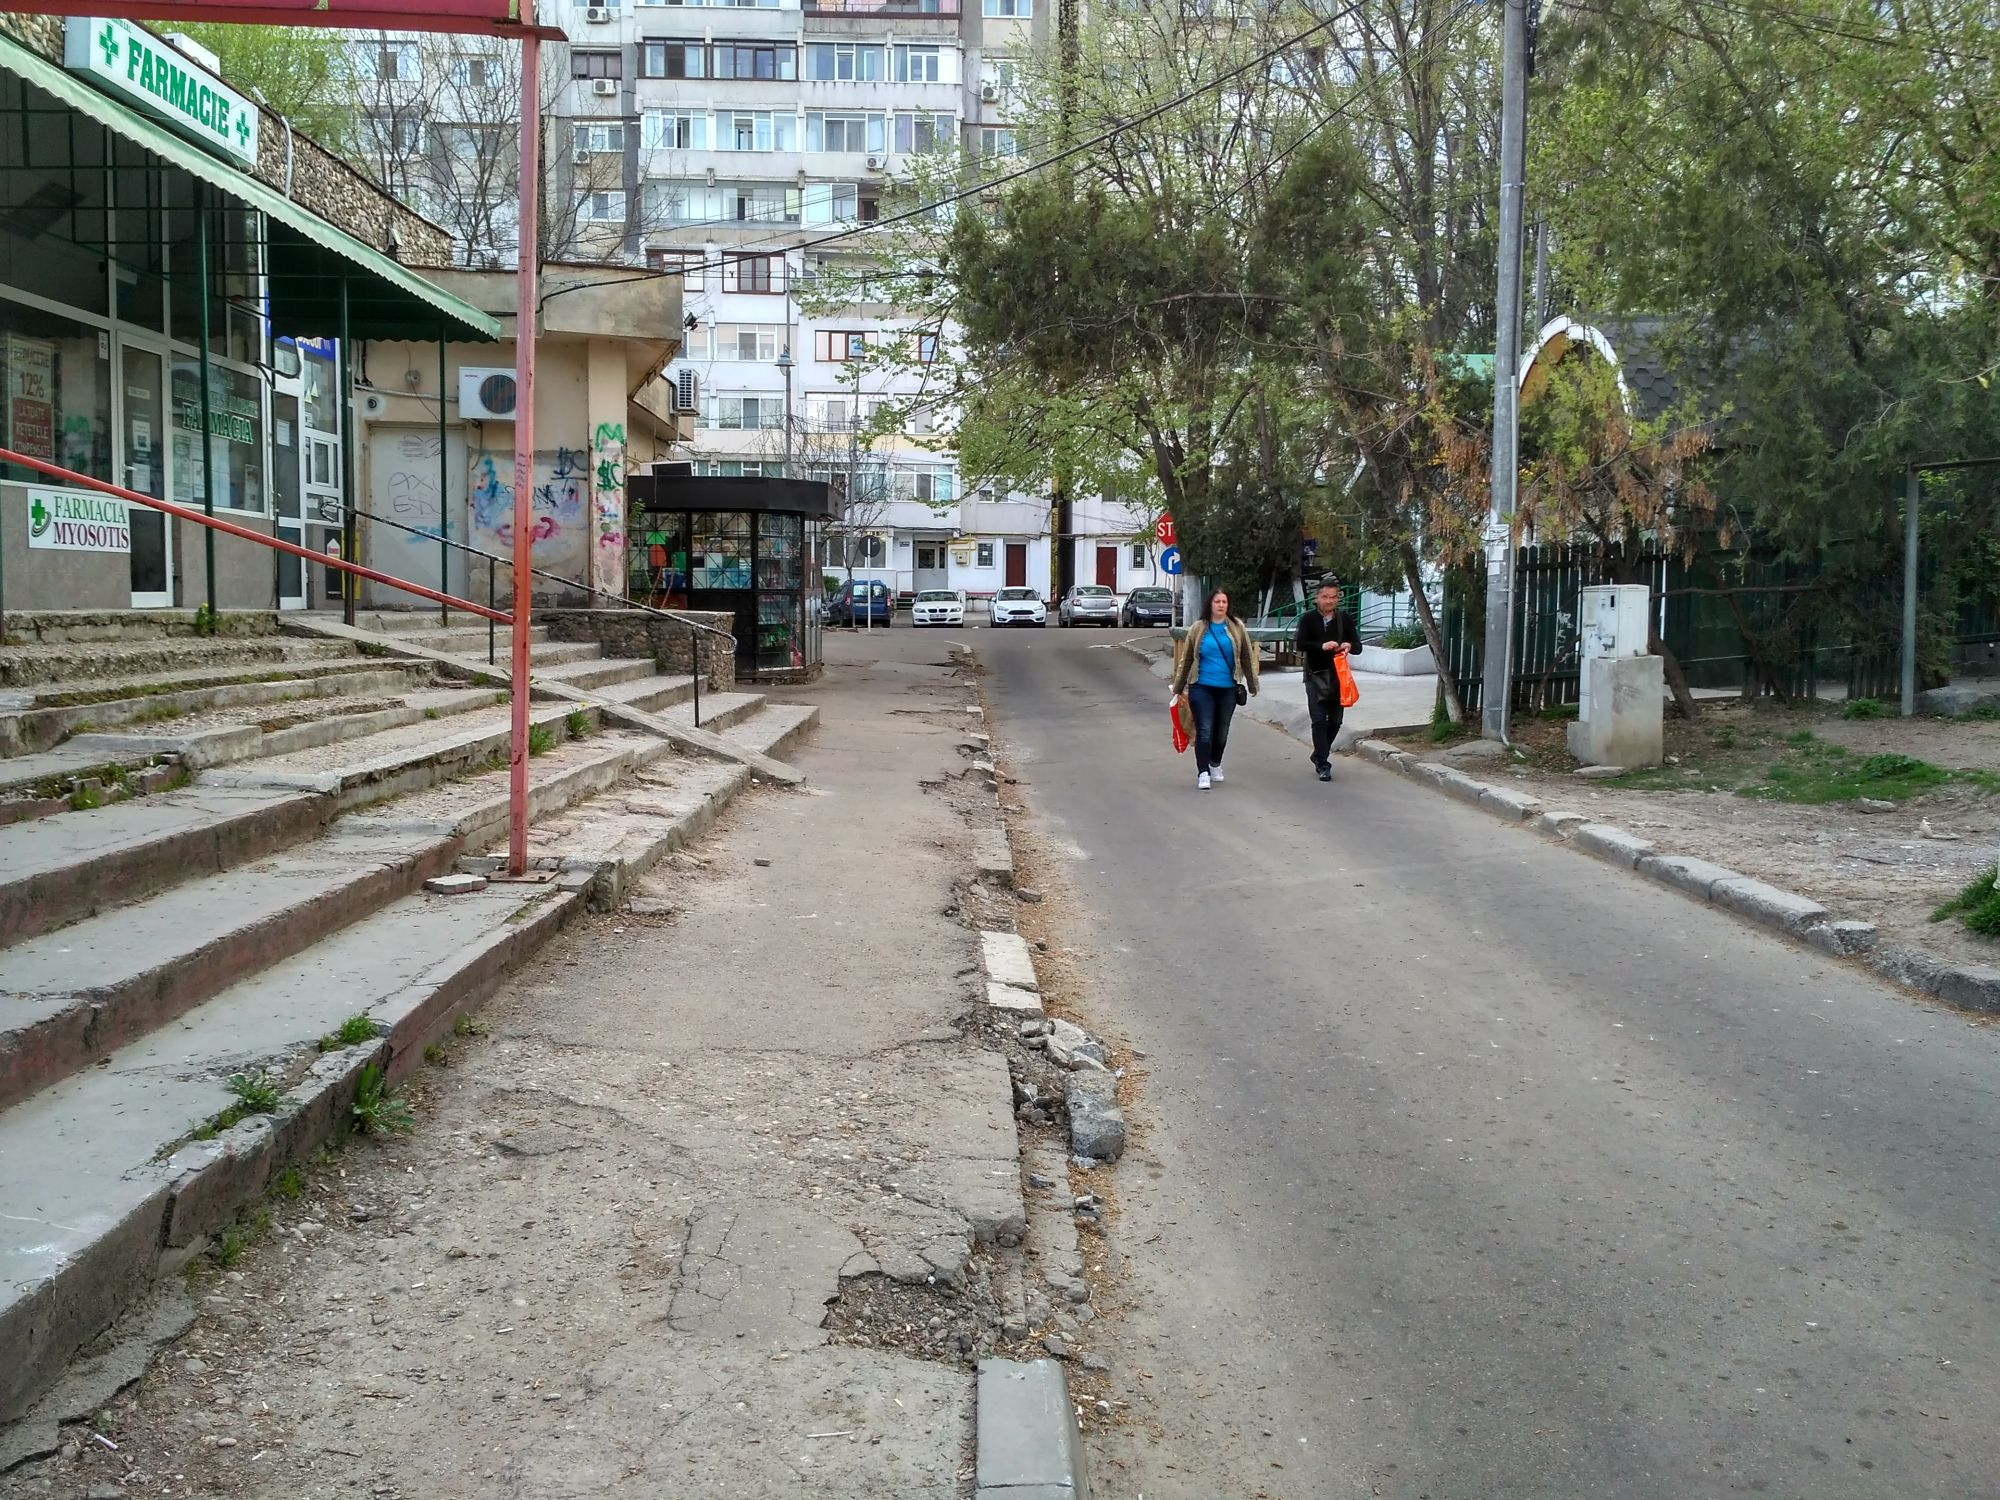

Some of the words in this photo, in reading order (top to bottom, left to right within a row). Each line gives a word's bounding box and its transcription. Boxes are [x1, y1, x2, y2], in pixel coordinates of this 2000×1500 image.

[127, 36, 230, 138] FARMACIE
[19, 370, 45, 399] 12%
[183, 402, 253, 444] FAMACIA
[53, 495, 127, 524] FARMACIA
[52, 521, 130, 549] MYOSOTIS
[1157, 521, 1174, 537] ST
